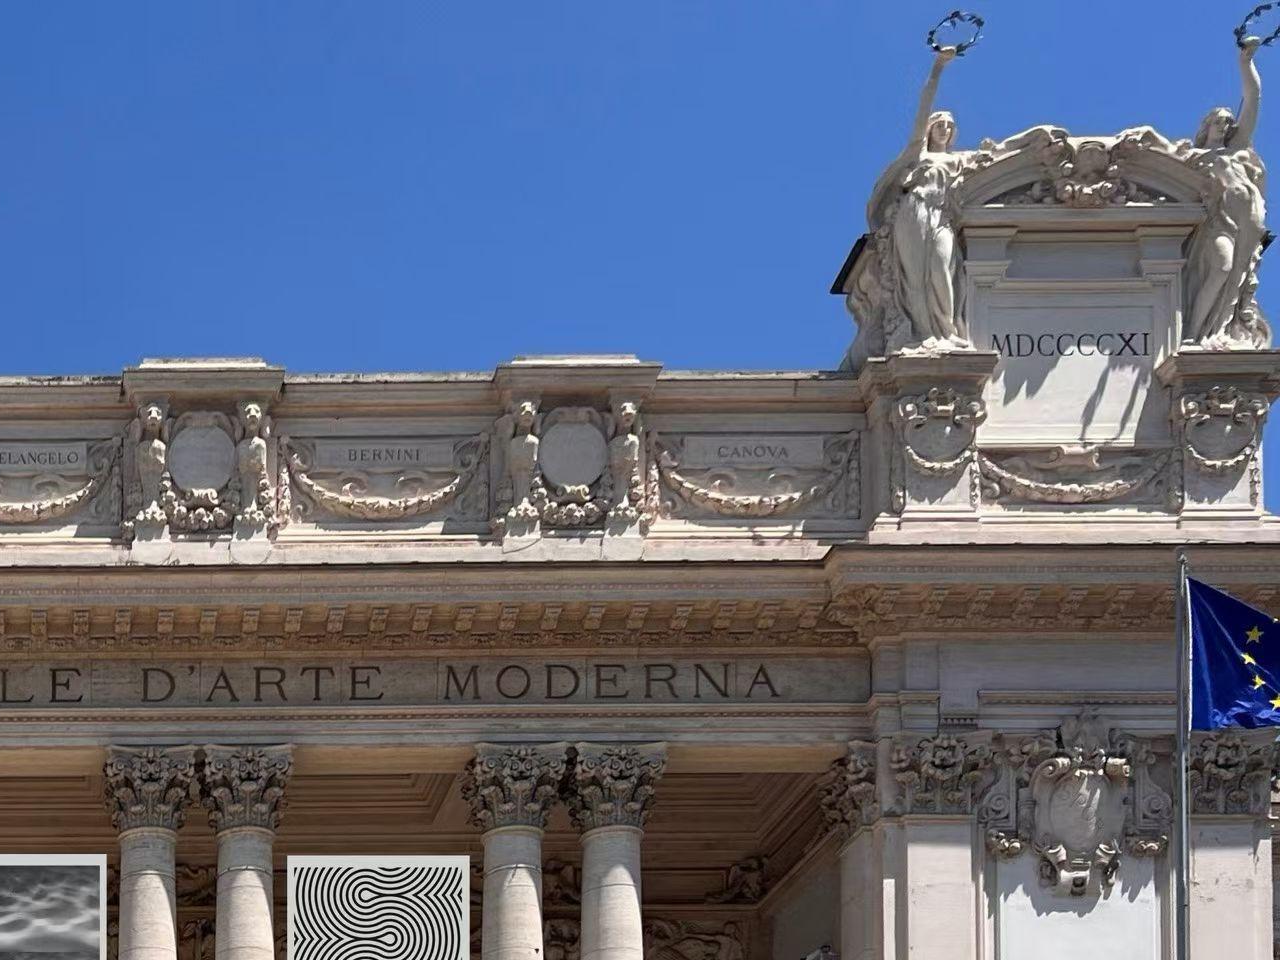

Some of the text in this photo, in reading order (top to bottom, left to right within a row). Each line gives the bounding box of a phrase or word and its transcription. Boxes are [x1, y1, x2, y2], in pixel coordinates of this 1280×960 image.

[991, 332, 1151, 357] MDCCCCXI
[348, 448, 420, 462] BERNINI
[717, 446, 788, 458] CANOVA
[140, 665, 384, 703] D'ARTE
[443, 664, 782, 700] MODERNA
